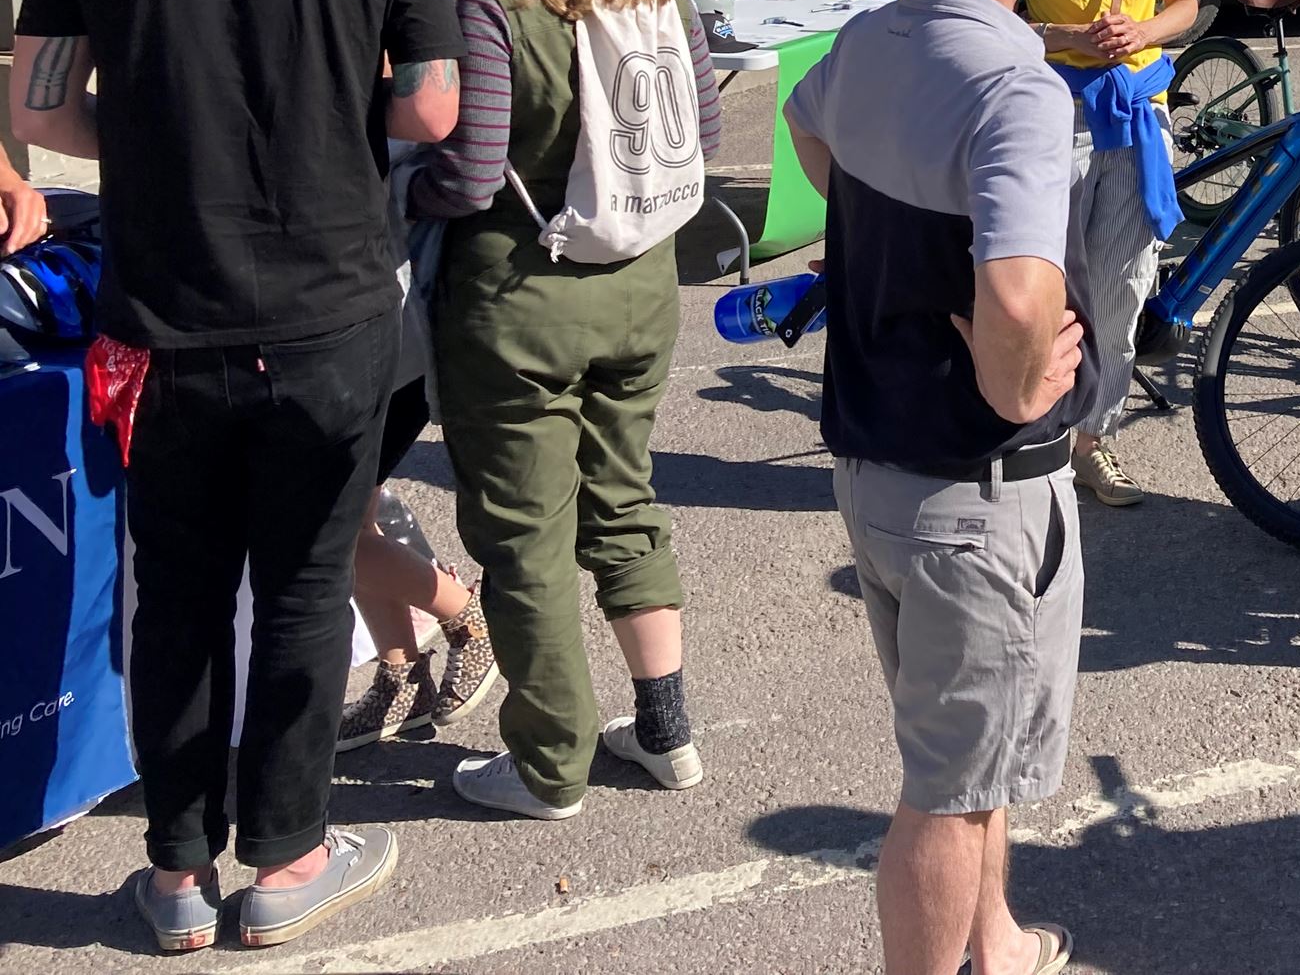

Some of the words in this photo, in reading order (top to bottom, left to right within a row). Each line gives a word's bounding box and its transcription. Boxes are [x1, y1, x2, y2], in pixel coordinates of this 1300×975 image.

[609, 47, 700, 175] 90
[623, 181, 700, 215] marzocco
[0, 714, 23, 739] ng
[30, 691, 74, 722] Care.
